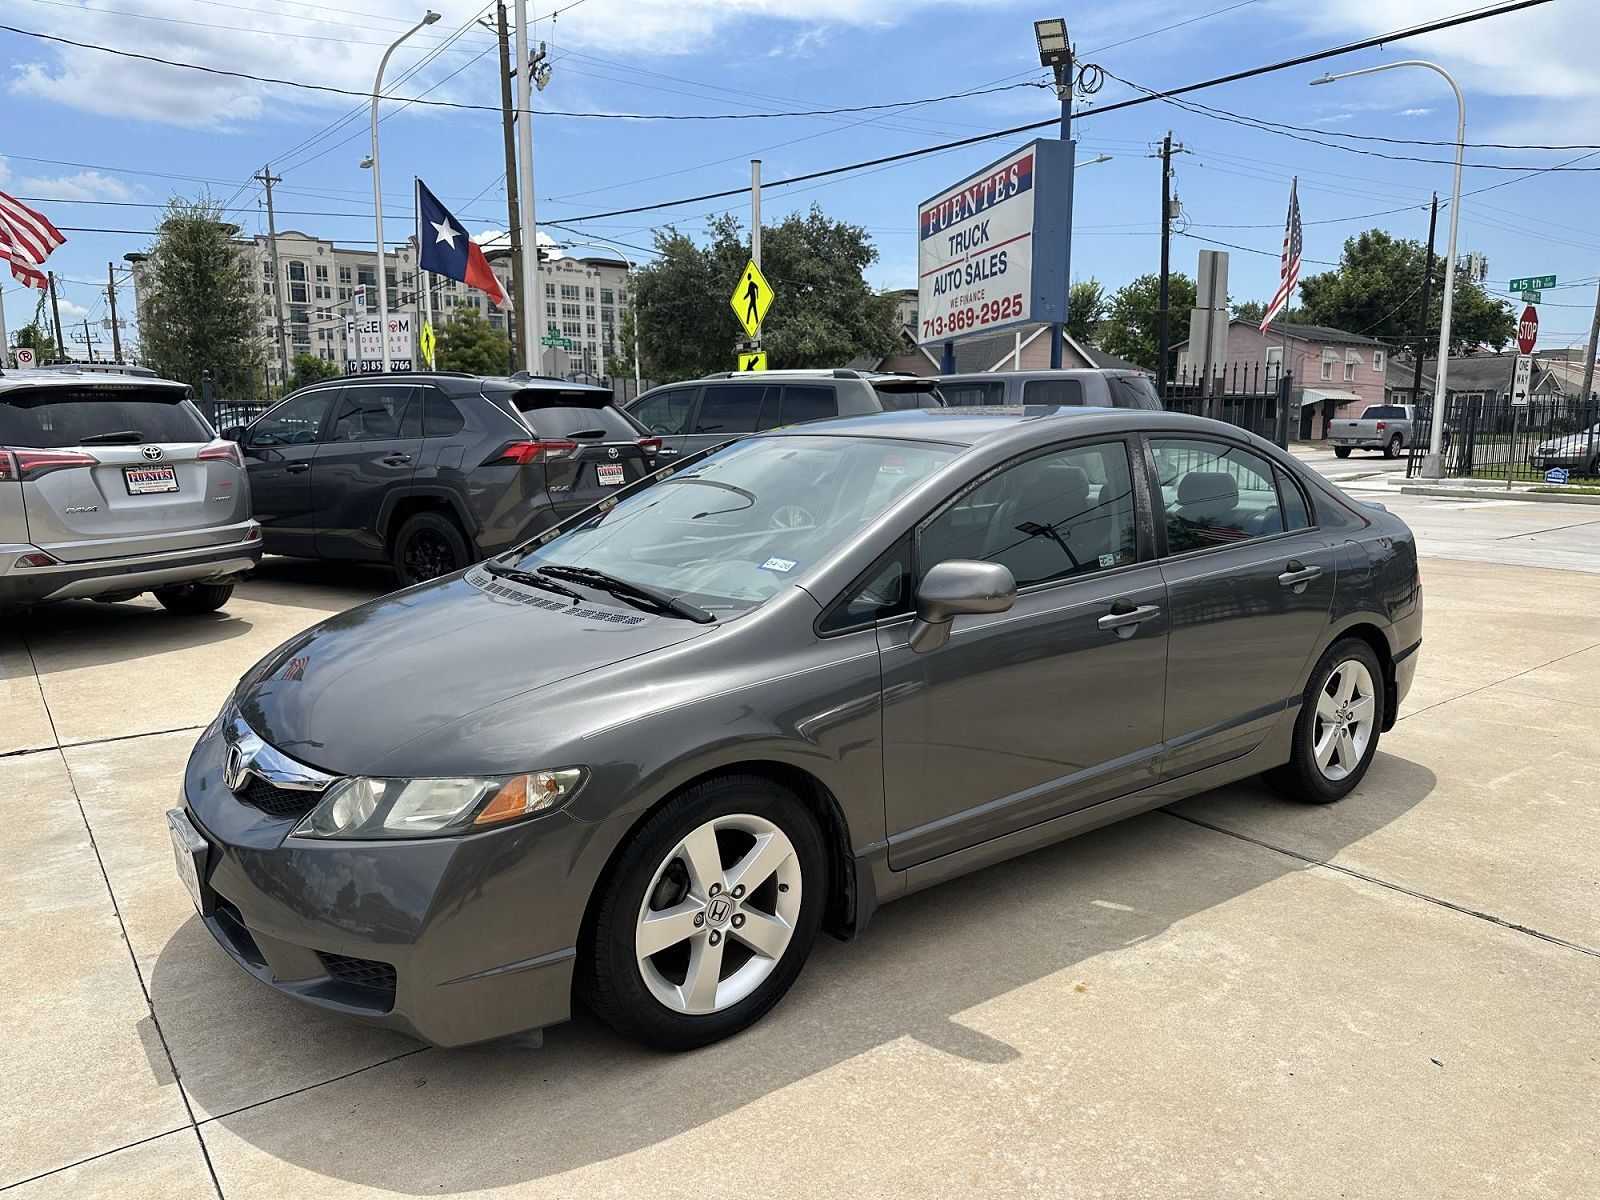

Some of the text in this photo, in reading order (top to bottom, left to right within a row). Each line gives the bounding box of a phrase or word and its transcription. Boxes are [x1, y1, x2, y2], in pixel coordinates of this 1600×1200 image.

[928, 164, 1018, 235] FUENTES
[948, 219, 990, 256] TRUCK
[933, 250, 1007, 297] AUTO SALES
[950, 288, 985, 309] WE FINANCE
[923, 293, 1023, 338] 713-869-2925
[349, 335, 409, 344] RDESARE
[1519, 320, 1537, 341] STOP
[350, 360, 370, 372] (73)
[1518, 360, 1530, 371] ONE
[1516, 374, 1529, 385] WAY
[130, 471, 171, 482] FUENTES
